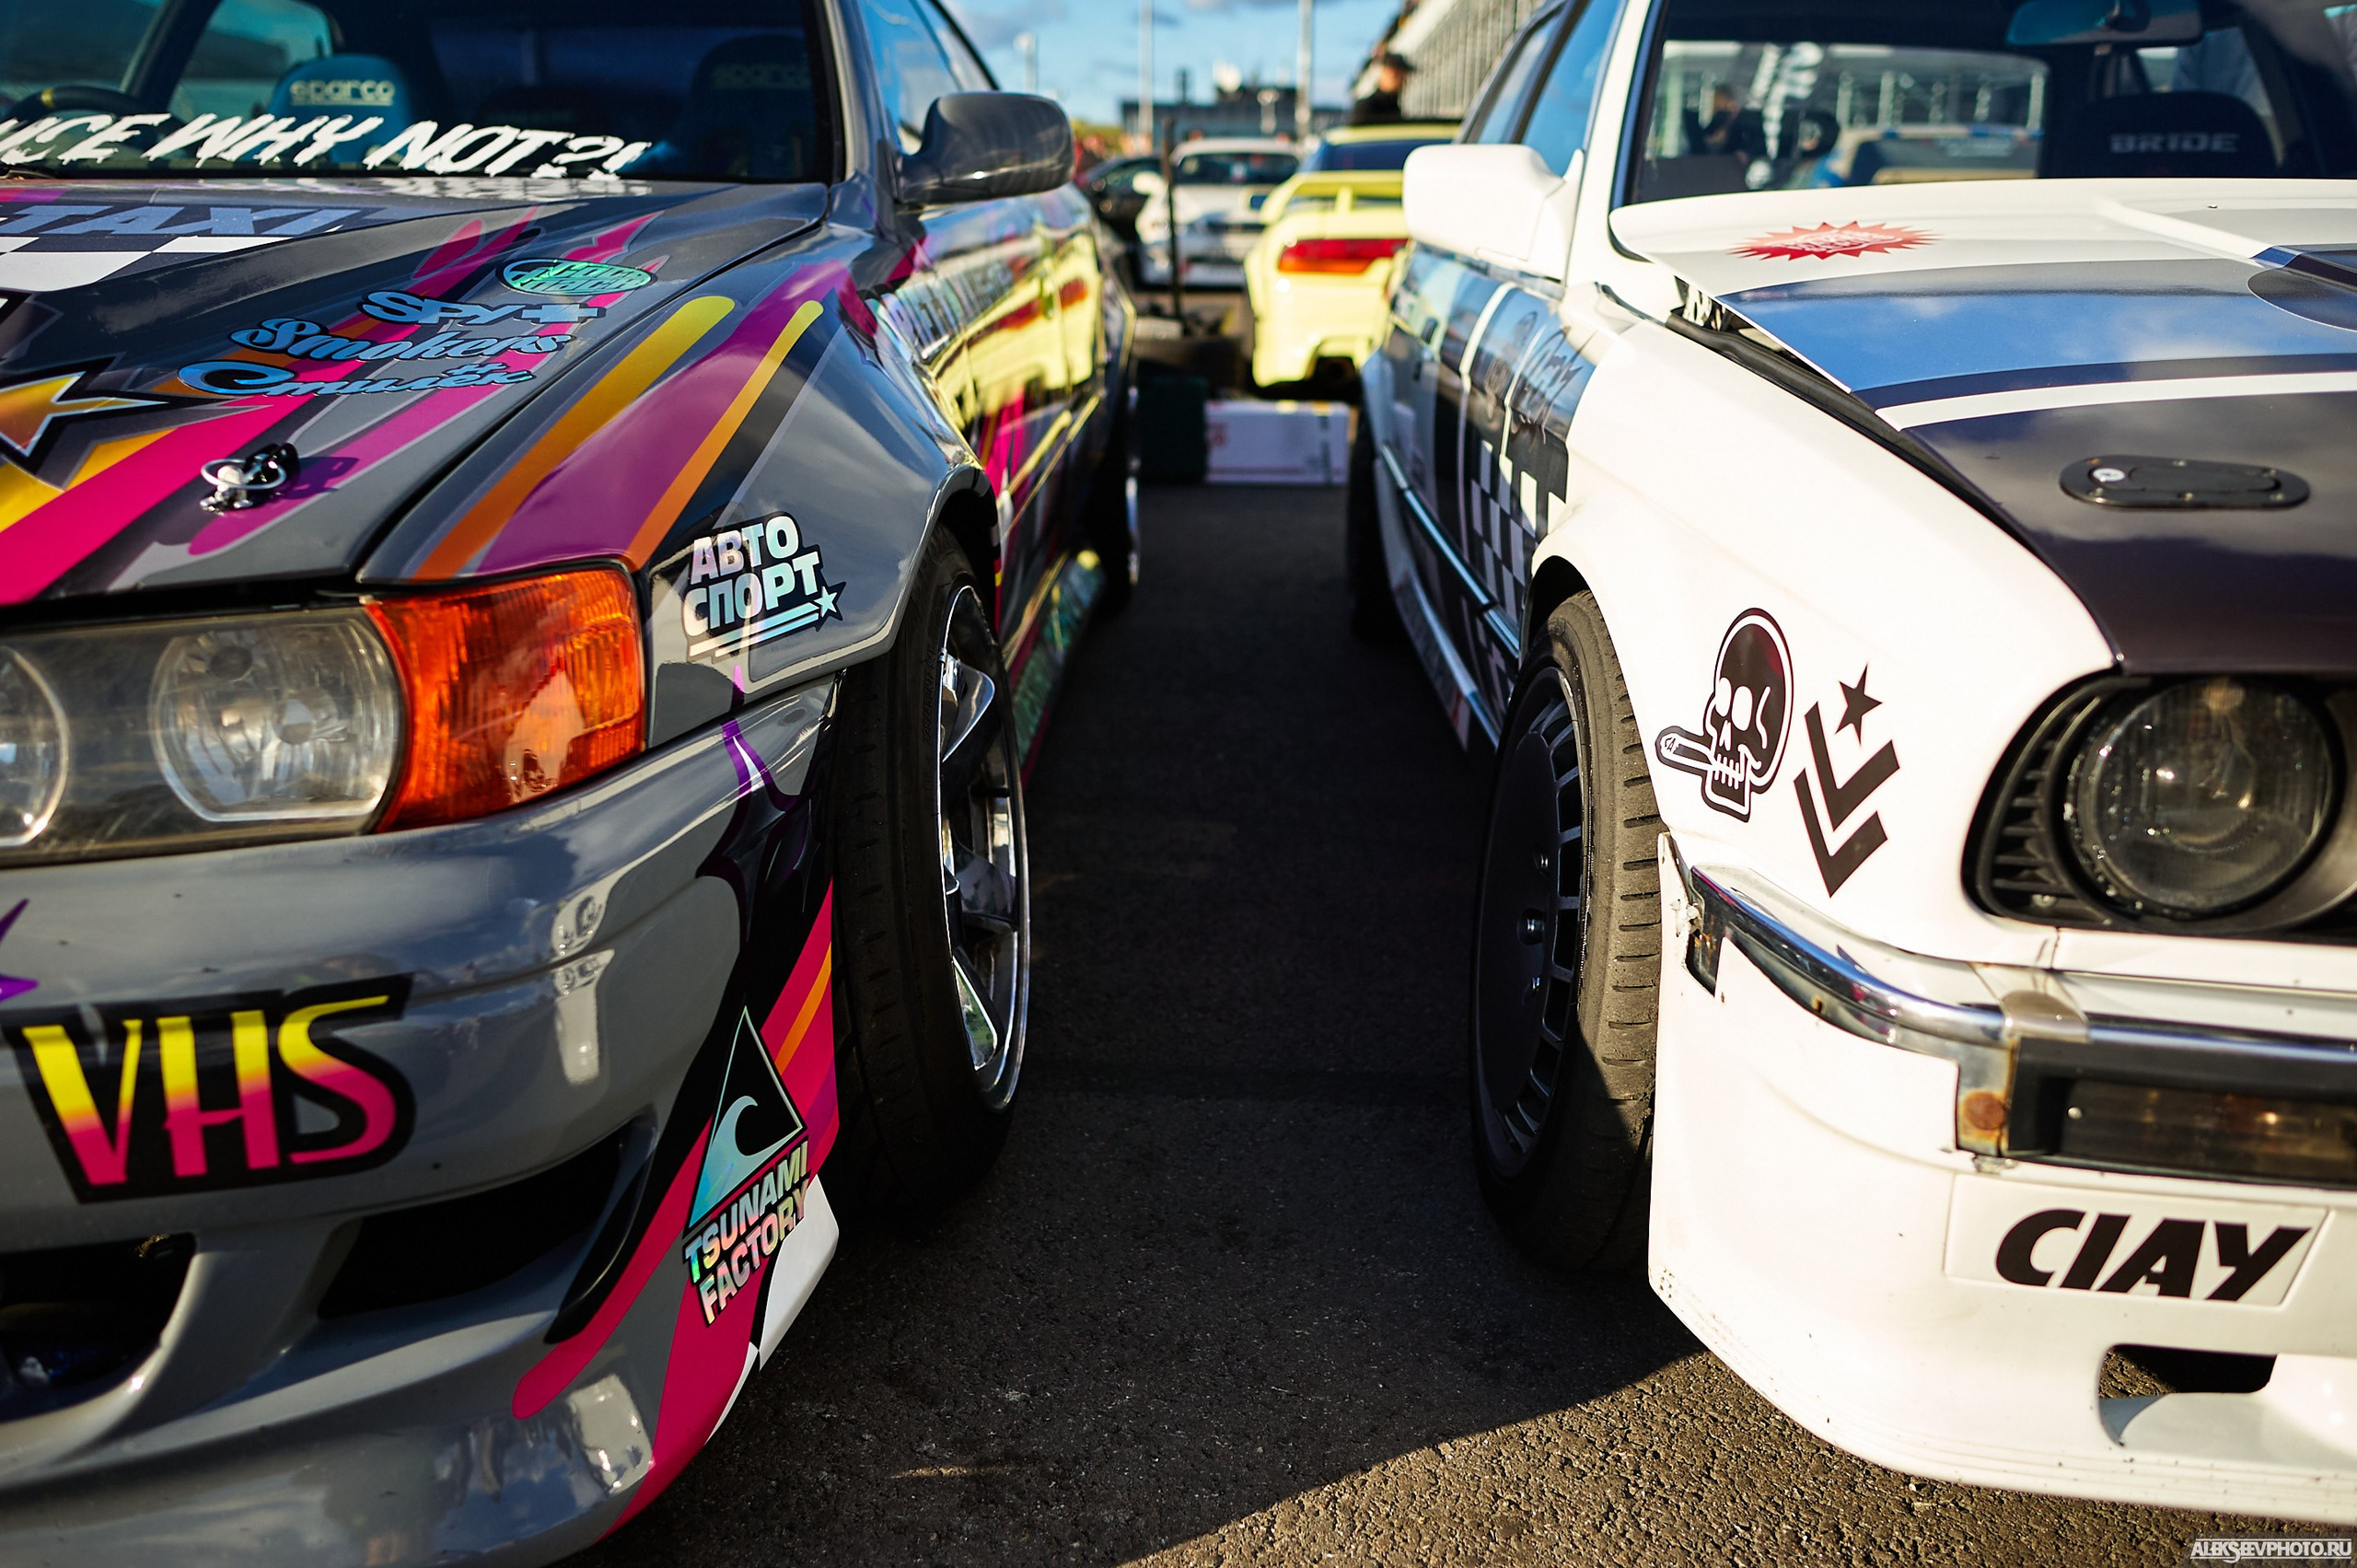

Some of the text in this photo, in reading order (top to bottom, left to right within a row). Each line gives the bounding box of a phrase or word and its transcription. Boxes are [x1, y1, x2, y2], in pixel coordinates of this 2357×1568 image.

[140, 112, 385, 168] WHY
[362, 120, 652, 180] NOT?!
[2110, 132, 2241, 153] BRIDE
[0, 205, 362, 235] TAXI
[231, 318, 574, 361] Smokers
[691, 516, 799, 585] АВТО
[683, 551, 820, 637] СПОРТ
[21, 995, 397, 1186] VHS
[685, 1141, 808, 1283] TSUNAMI
[699, 1179, 809, 1324] FACTORY
